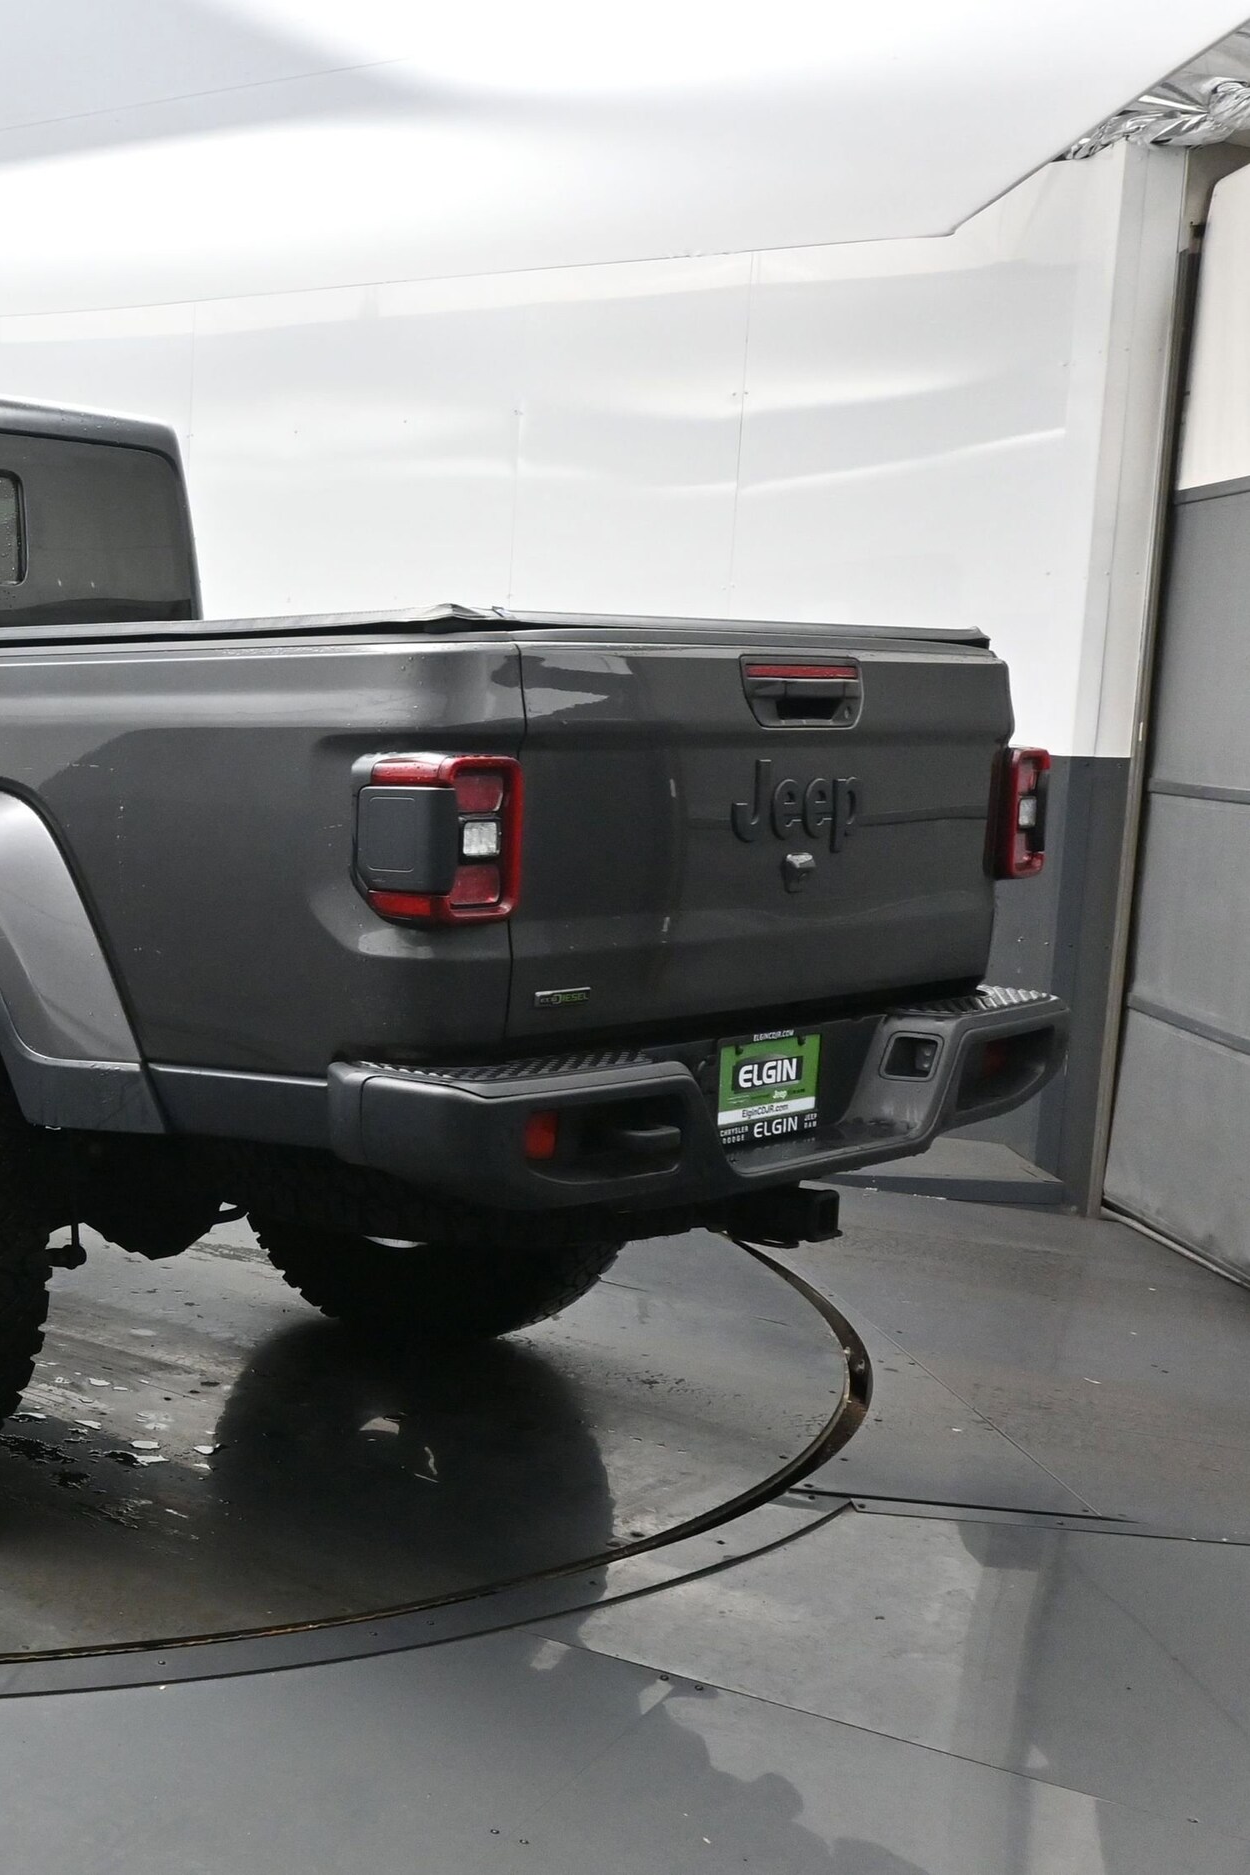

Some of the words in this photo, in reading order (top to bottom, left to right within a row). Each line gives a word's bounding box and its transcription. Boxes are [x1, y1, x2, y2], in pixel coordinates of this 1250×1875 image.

[731, 759, 857, 854] Jeep
[738, 1058, 797, 1088] ELGIN
[742, 1104, 789, 1120] ElginCDJR.com
[753, 1116, 797, 1137] ELGIN
